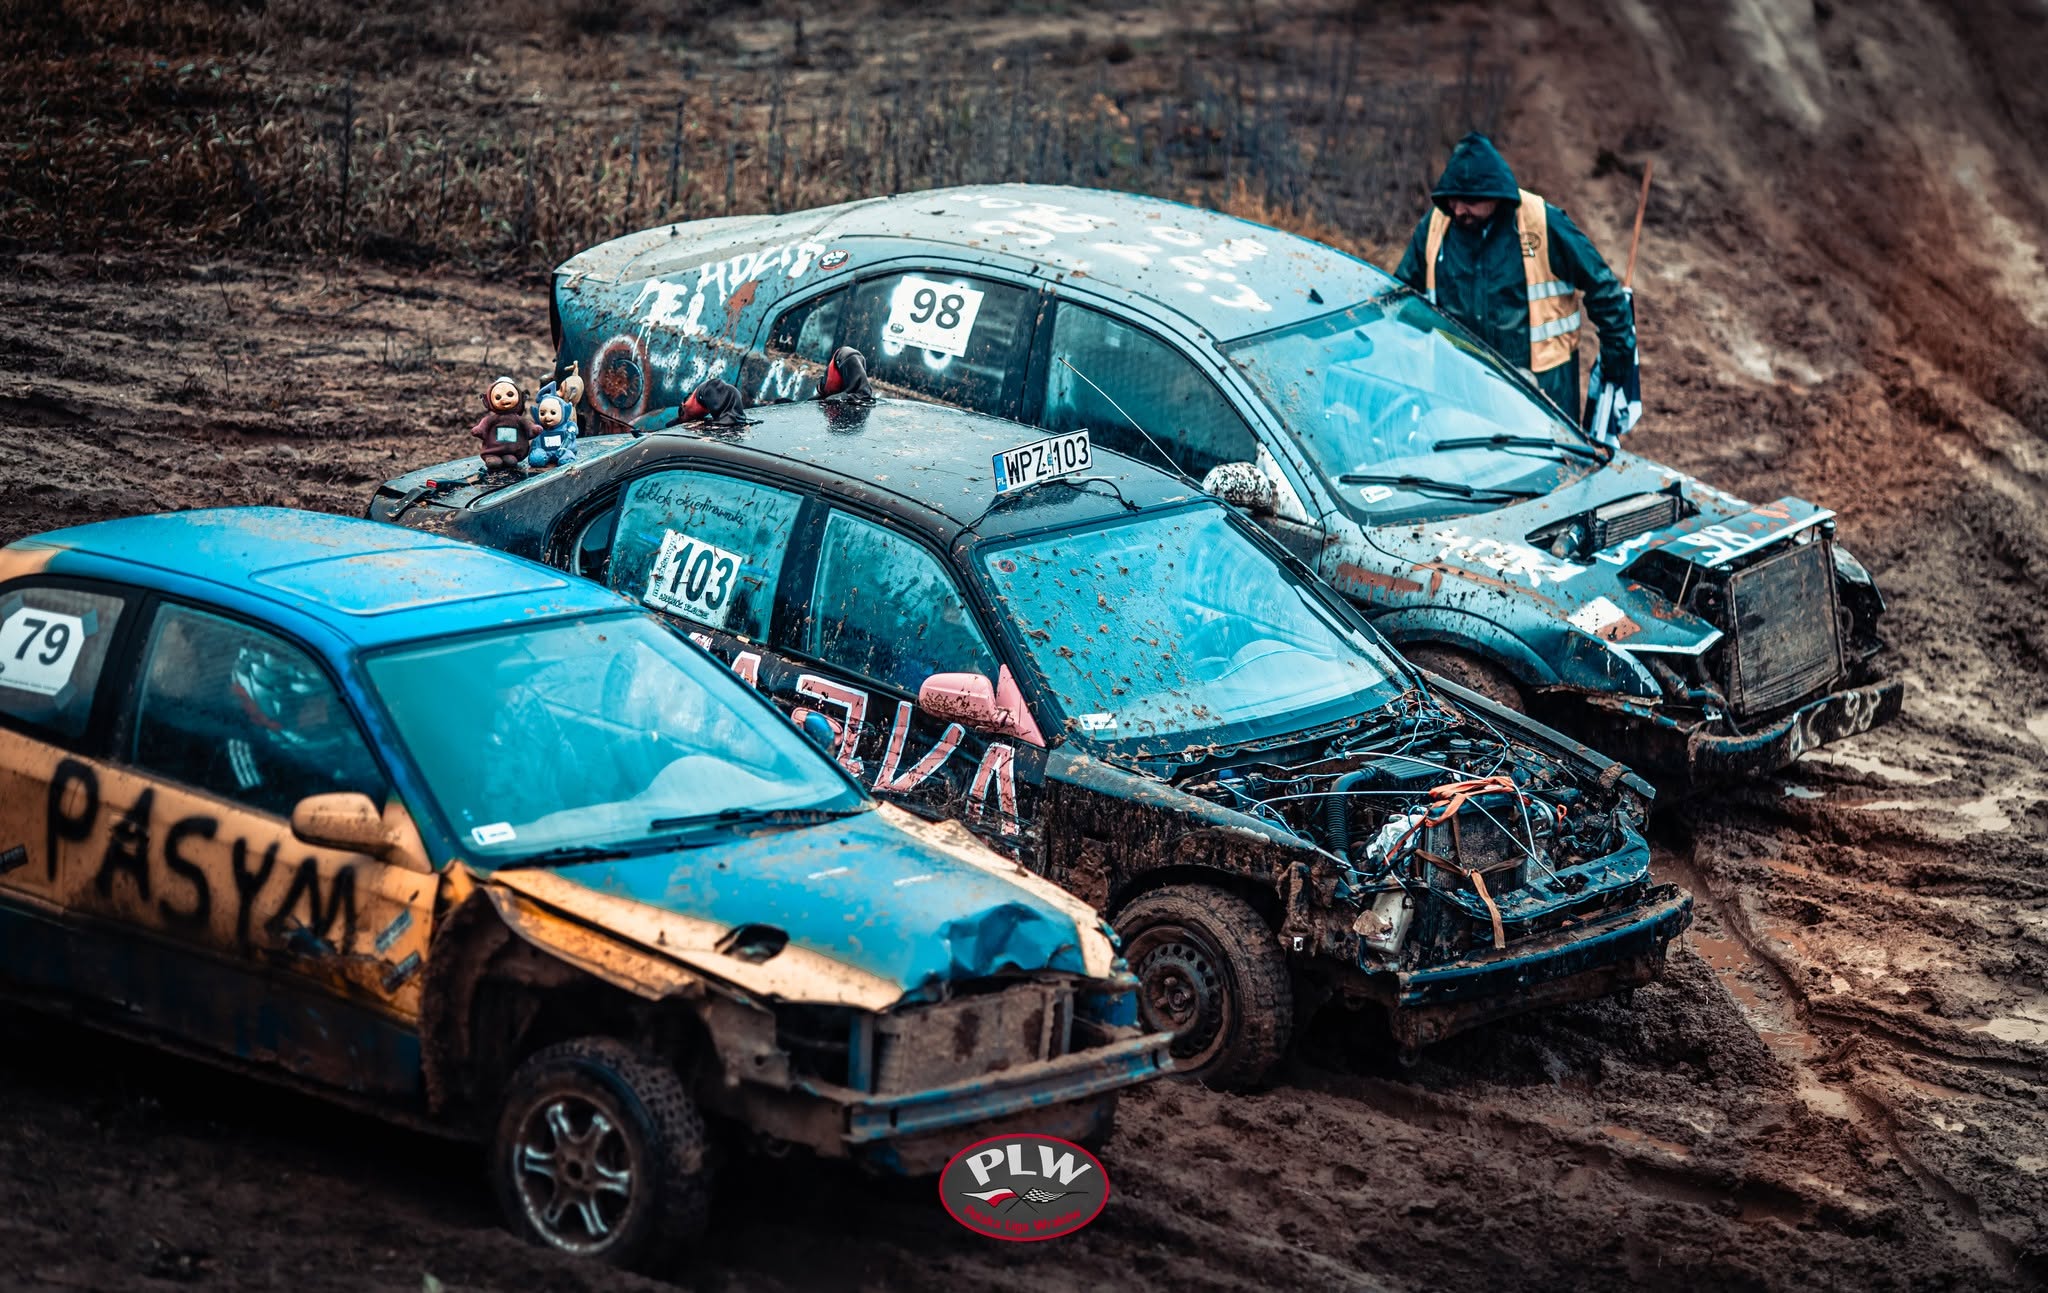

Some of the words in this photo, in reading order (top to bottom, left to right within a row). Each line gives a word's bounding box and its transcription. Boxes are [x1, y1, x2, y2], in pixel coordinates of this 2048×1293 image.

[909, 288, 965, 330] 98
[997, 477, 1006, 487] PL
[1005, 446, 1048, 486] WPZ
[1053, 436, 1090, 474] 103
[1677, 524, 1757, 565] 98
[669, 542, 734, 611] 103
[15, 617, 70, 666] 79
[46, 757, 358, 952] PASYM
